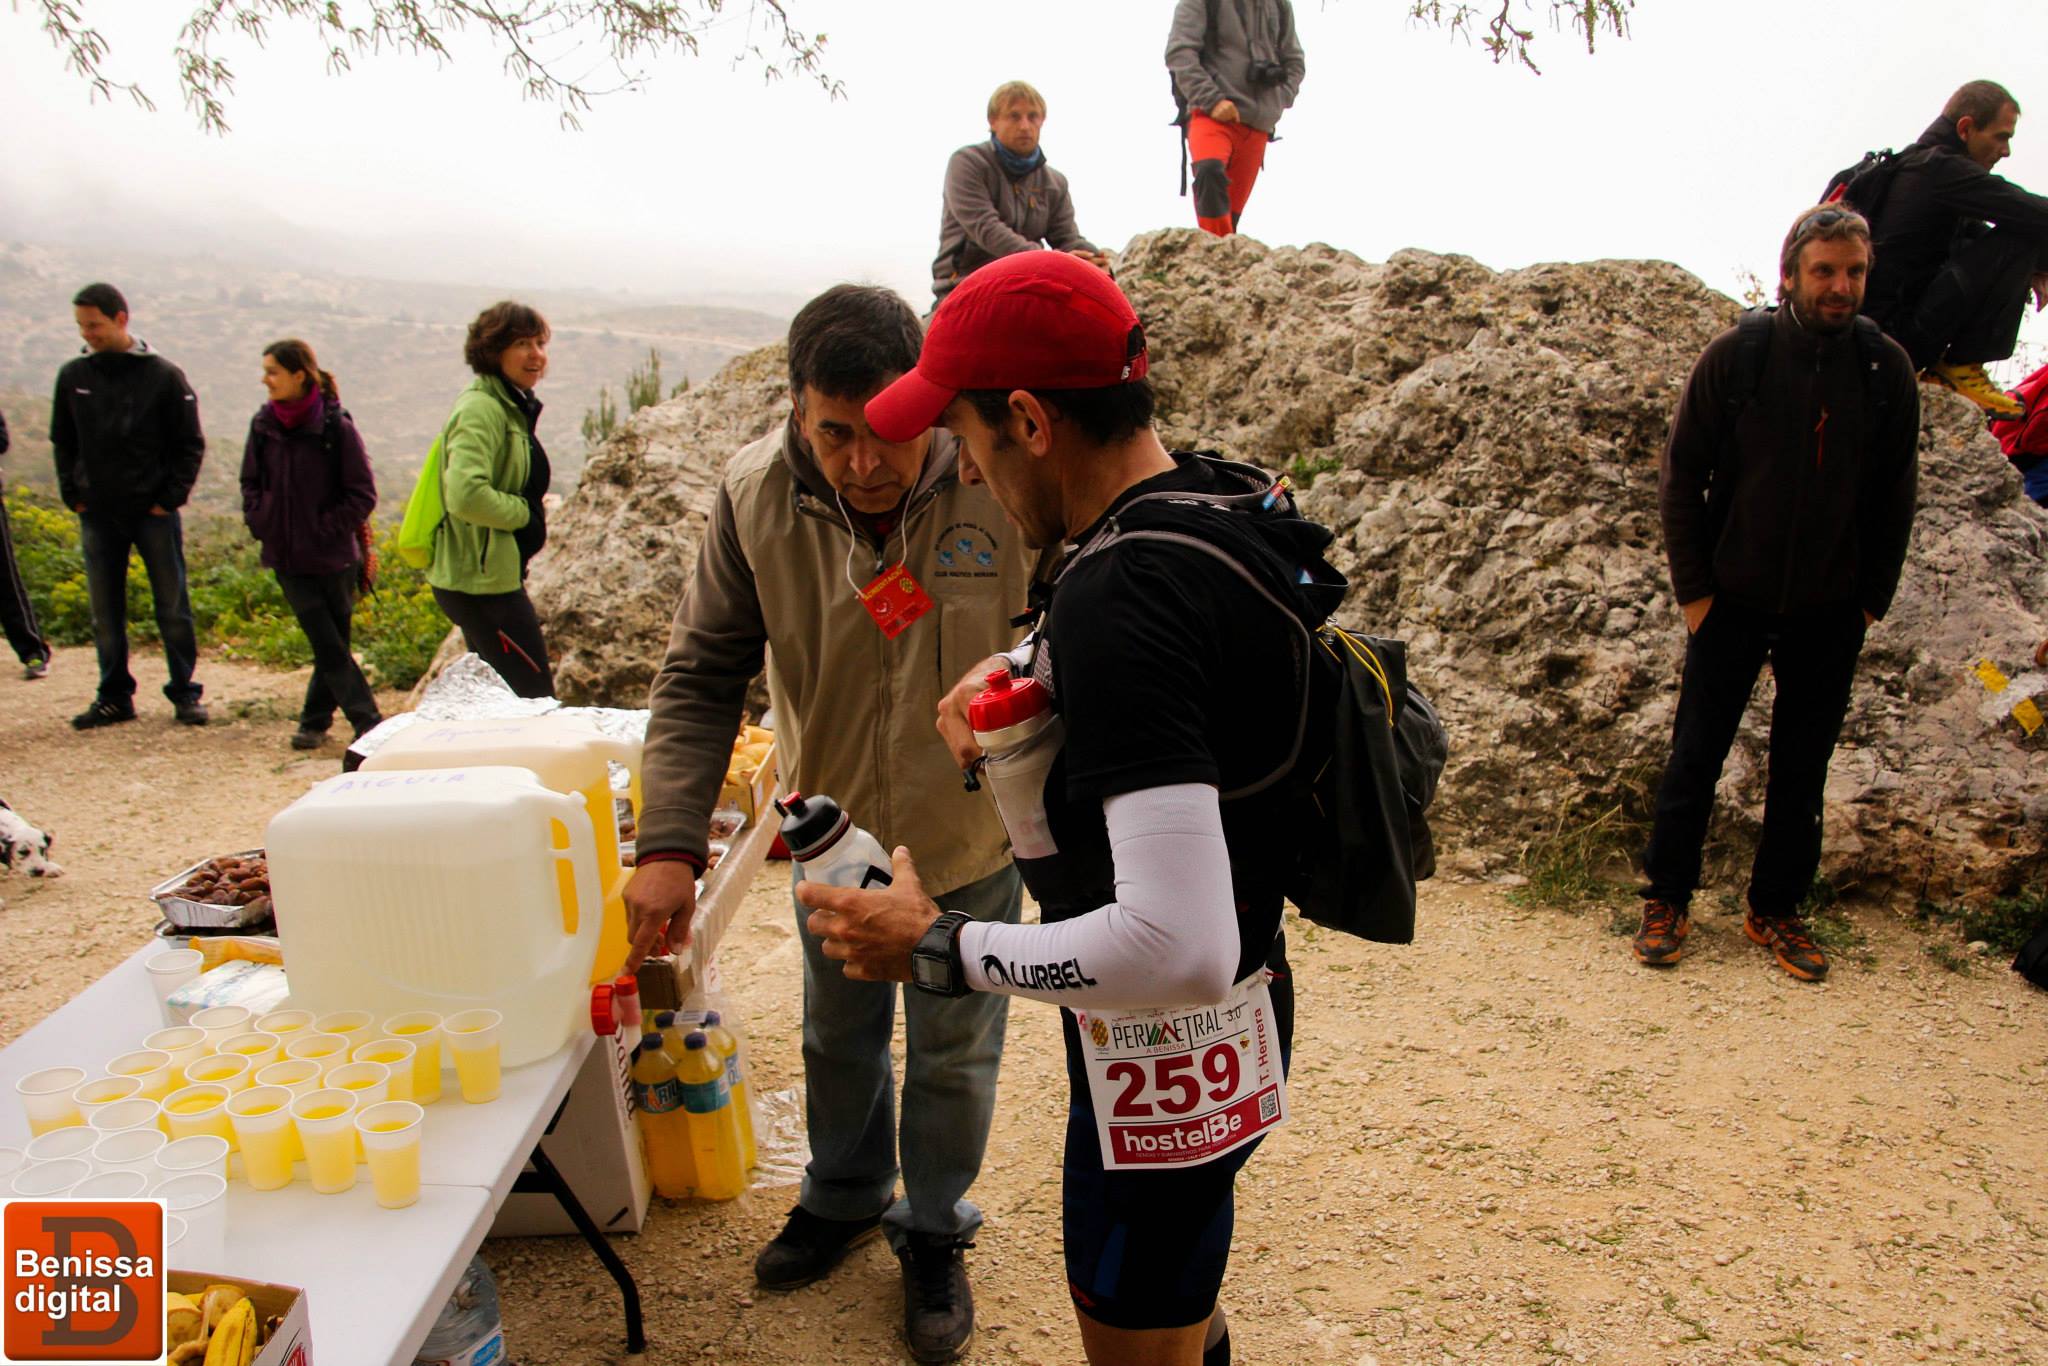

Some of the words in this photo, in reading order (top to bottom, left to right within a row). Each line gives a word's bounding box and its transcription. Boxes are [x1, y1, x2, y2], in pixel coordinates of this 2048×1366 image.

[1010, 957, 1098, 990] LURBEL
[1226, 1006, 1242, 1022] 3.0
[1254, 1007, 1269, 1068] Herrera
[1106, 1042, 1241, 1118] 259
